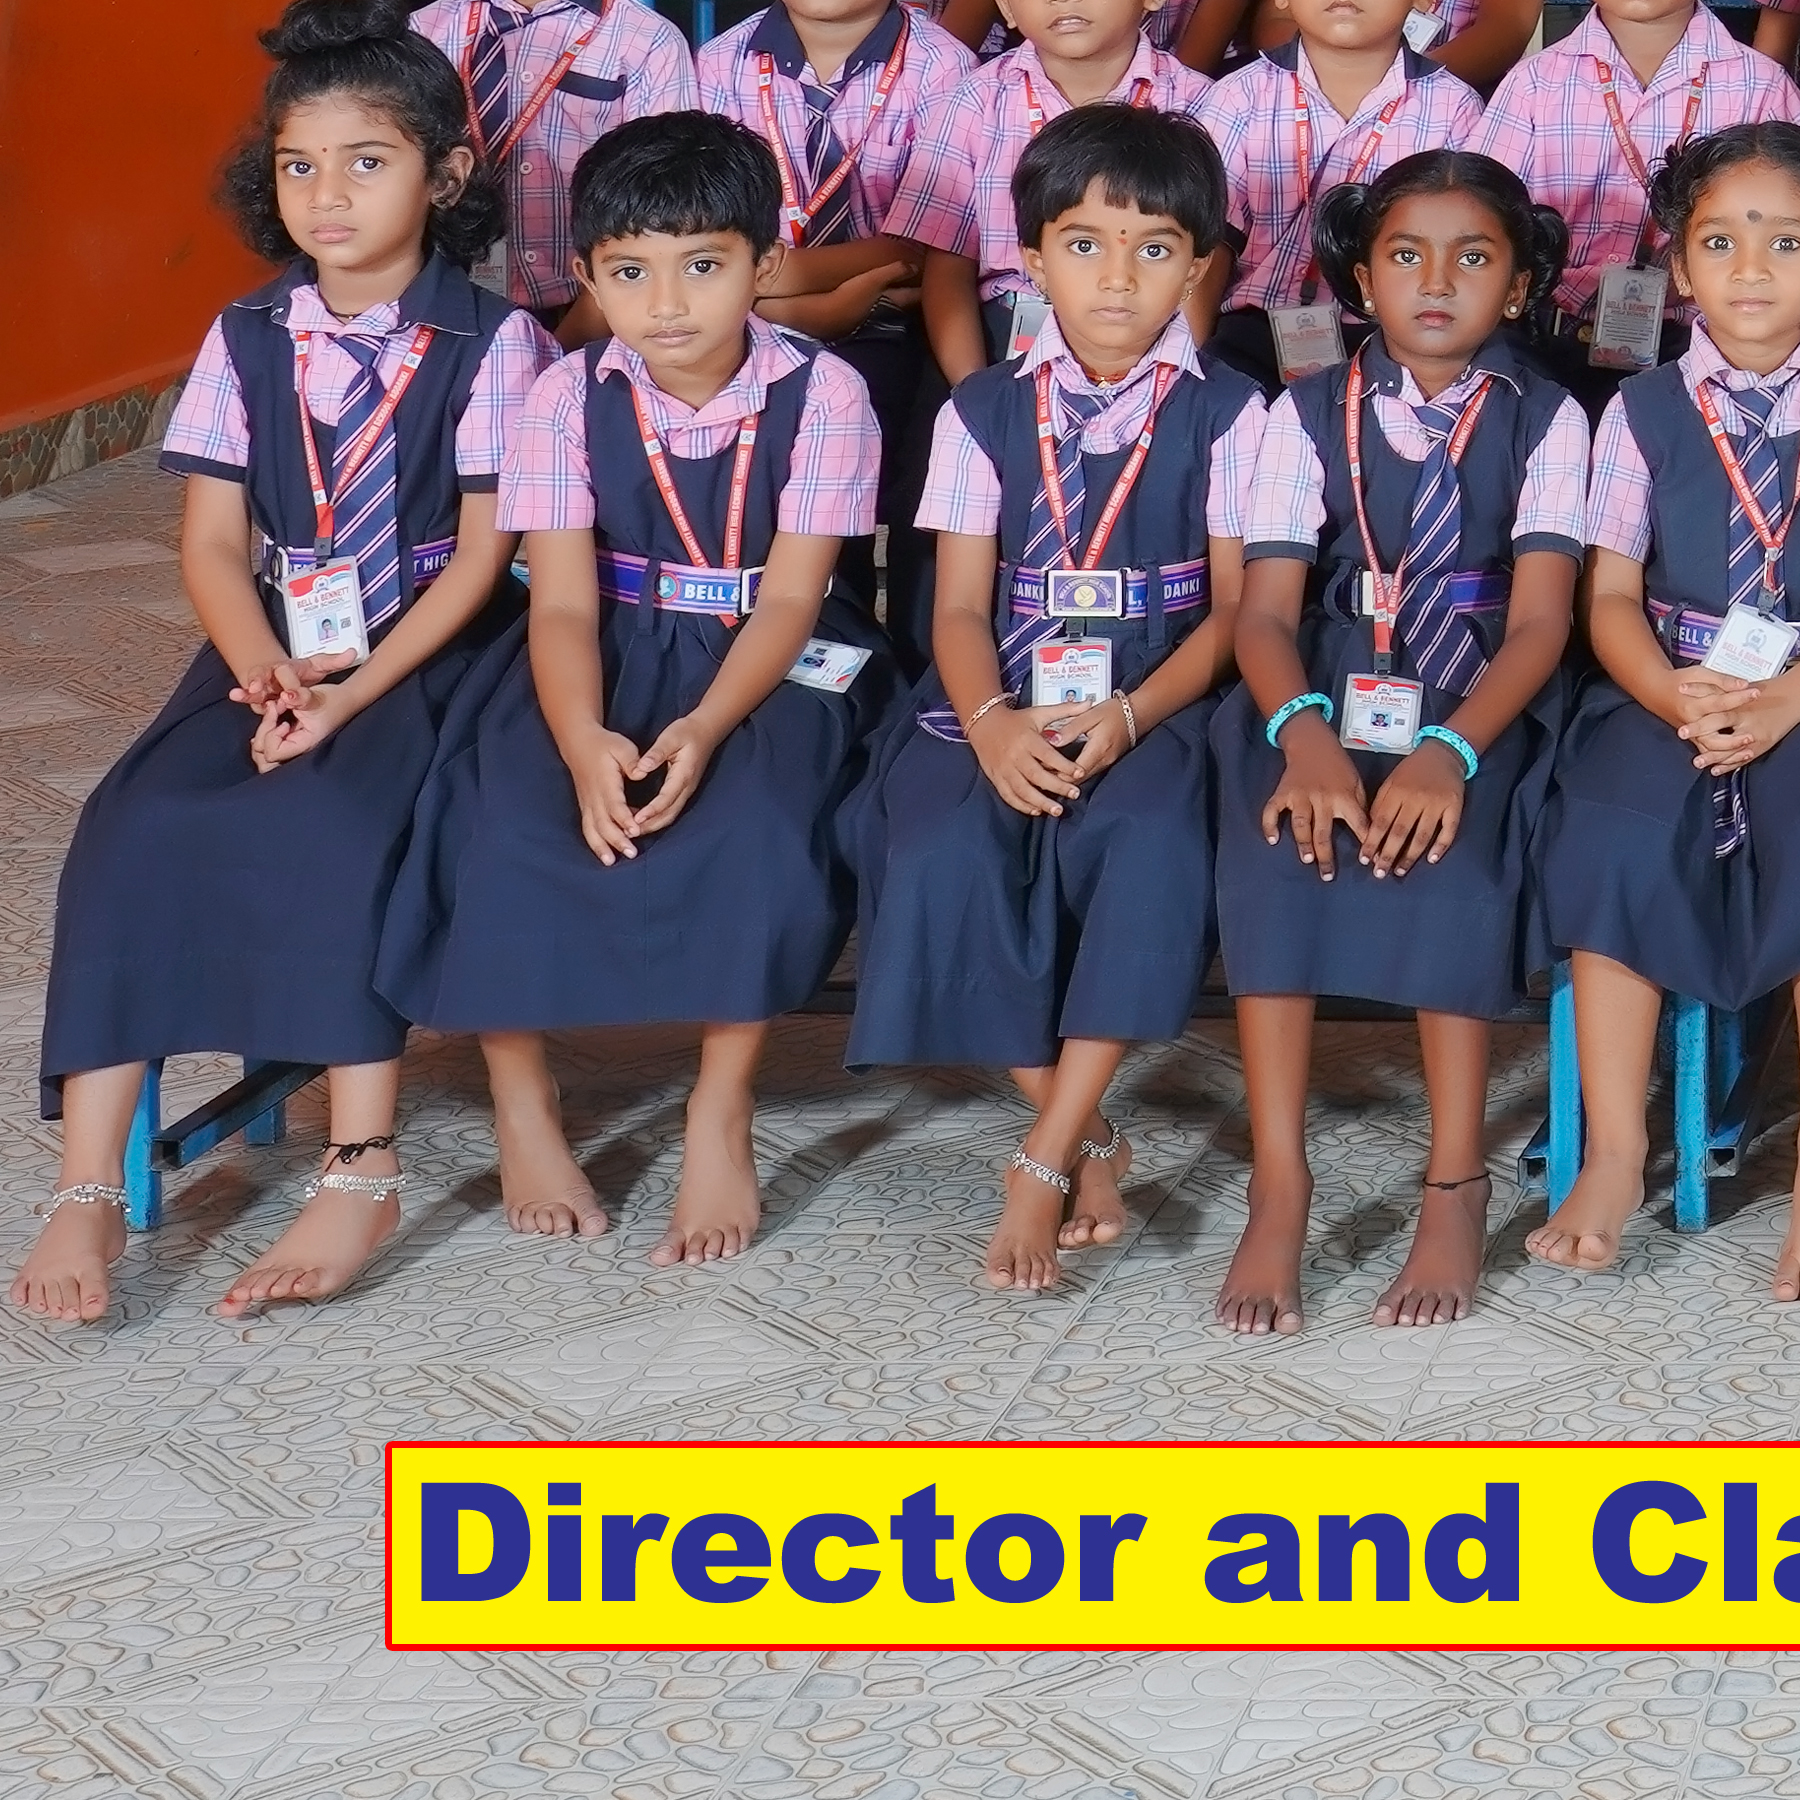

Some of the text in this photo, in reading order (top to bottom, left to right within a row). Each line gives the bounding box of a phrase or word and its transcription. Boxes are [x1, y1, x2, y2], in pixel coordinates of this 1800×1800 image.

[321, 586, 350, 602] BENNETT
[684, 583, 739, 602] BELL &
[1673, 625, 1713, 647] BELL &
